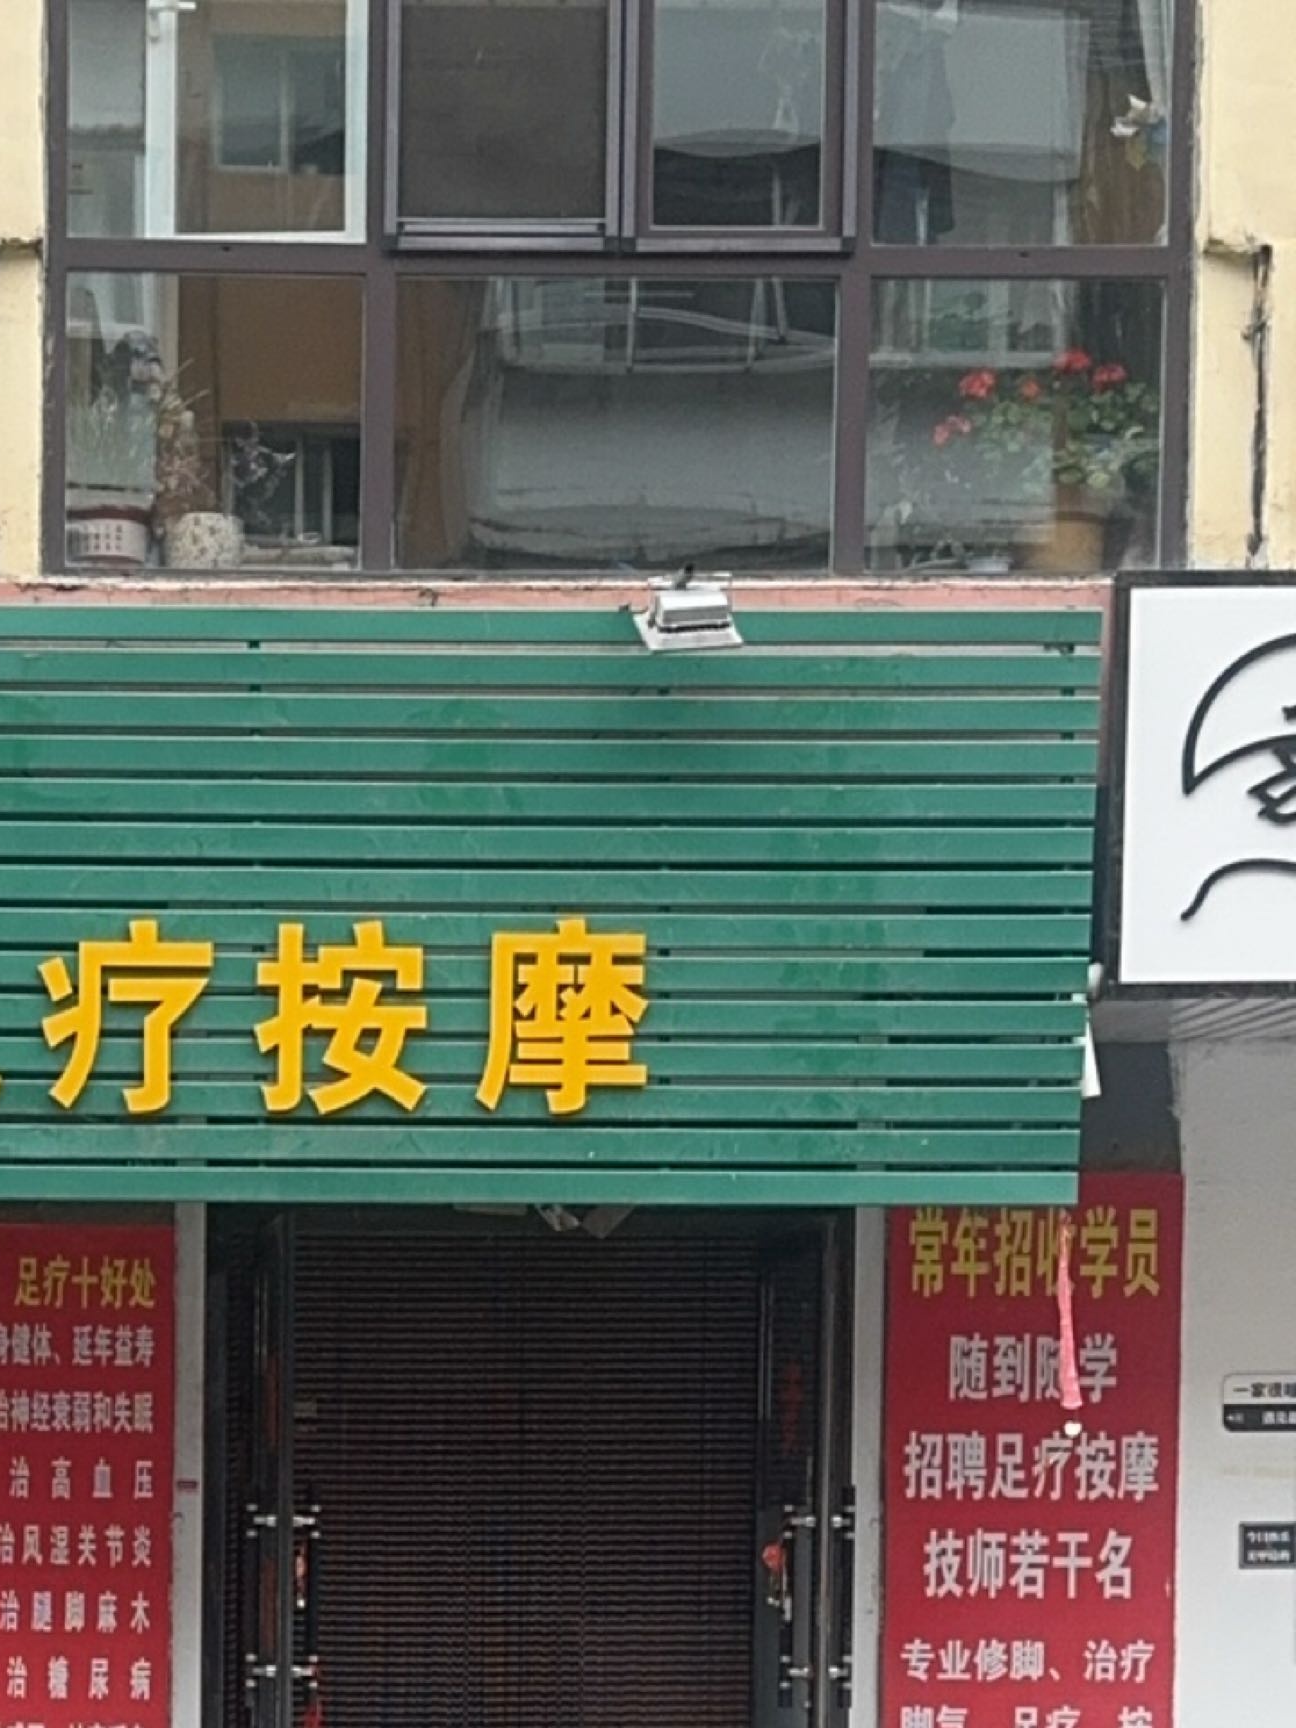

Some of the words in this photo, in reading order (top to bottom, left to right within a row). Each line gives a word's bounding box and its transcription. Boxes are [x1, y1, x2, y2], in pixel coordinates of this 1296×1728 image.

[903, 1430, 1159, 1501] 招聘足疗按摩
[923, 1528, 1133, 1600] 技师若干名
[900, 1639, 1155, 1683] 专业修脚、治疗
